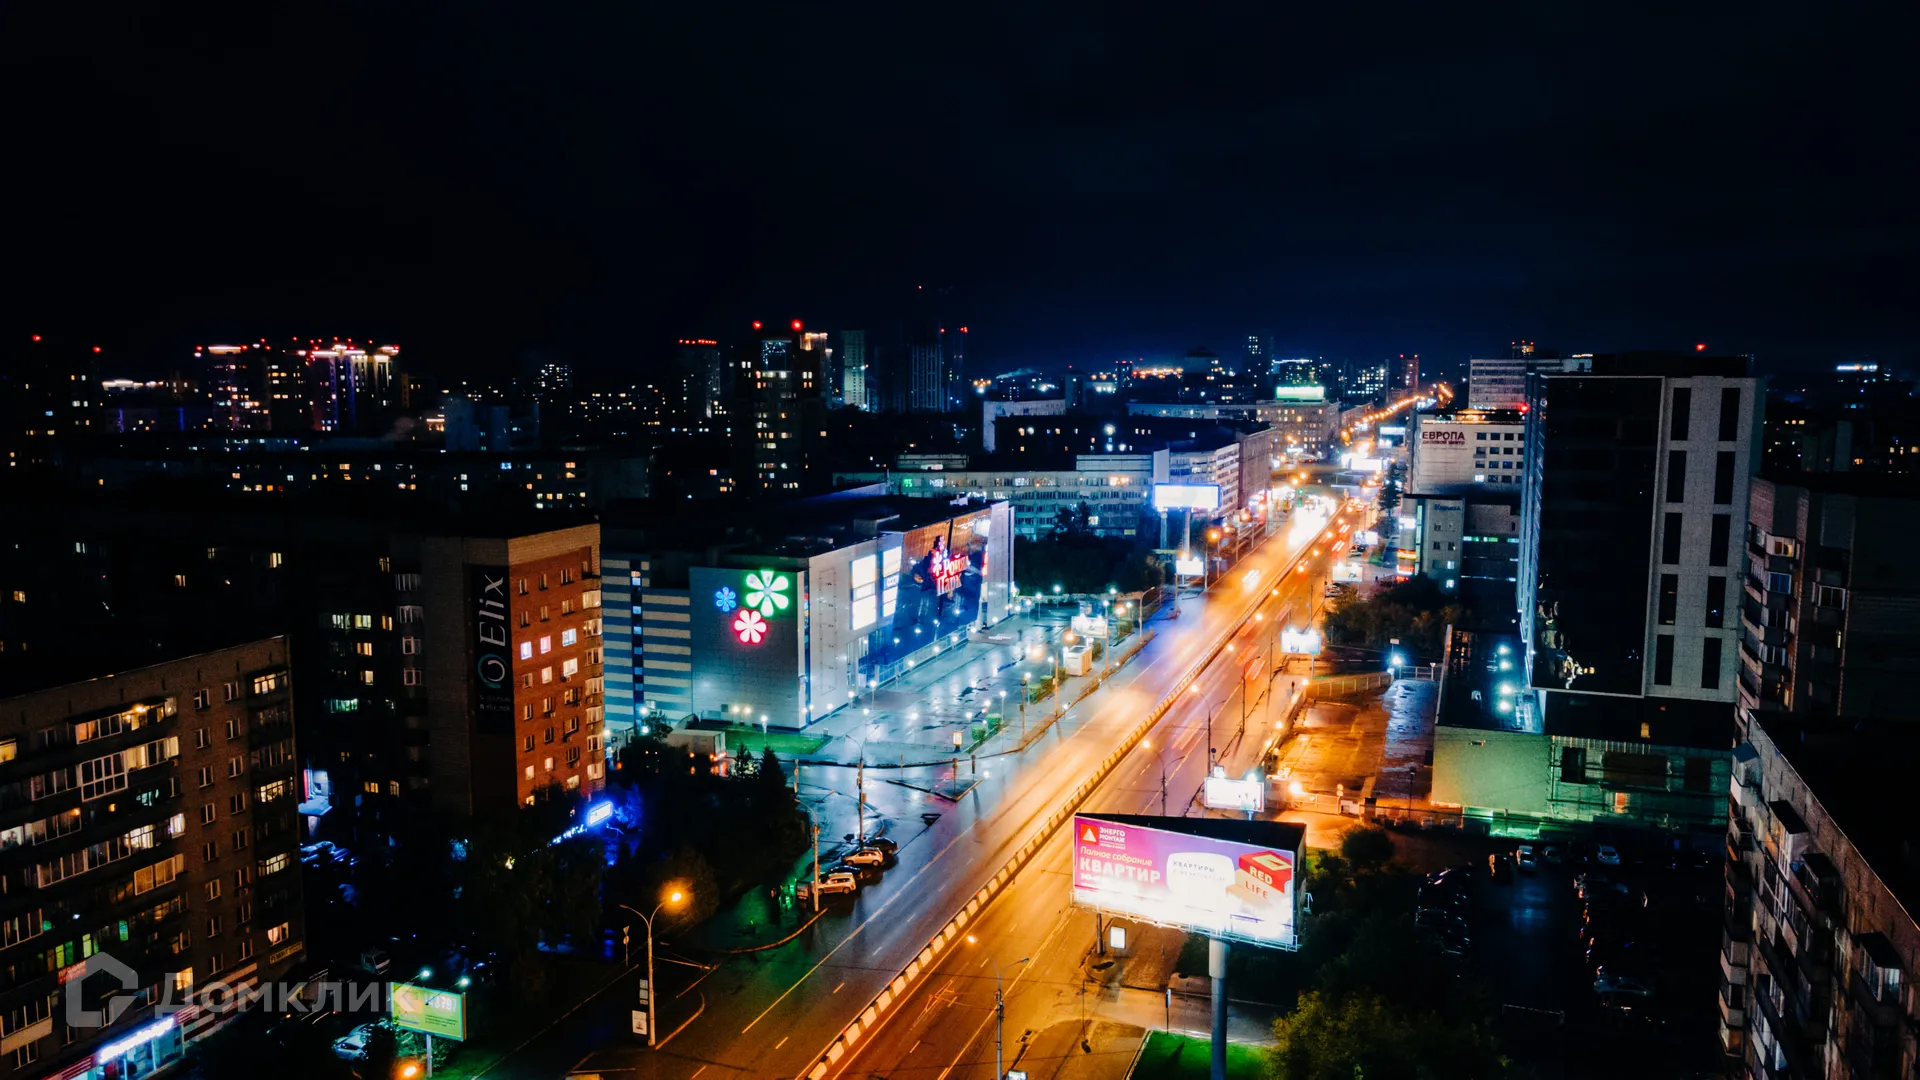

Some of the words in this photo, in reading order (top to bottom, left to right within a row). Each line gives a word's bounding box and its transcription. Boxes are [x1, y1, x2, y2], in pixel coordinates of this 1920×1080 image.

[1422, 431, 1465, 440] ЕВРОПА
[478, 574, 506, 647] Elix
[1099, 826, 1126, 837] ЭНЕРГО
[1099, 833, 1126, 843] МОНТАЖ
[1080, 845, 1111, 859] Полное
[1112, 853, 1153, 866] собрание
[1080, 857, 1161, 884] КВАРТИР
[1173, 860, 1215, 873] КВАРТИРЫ
[1249, 865, 1273, 885] RED
[1245, 880, 1269, 899] LIFE
